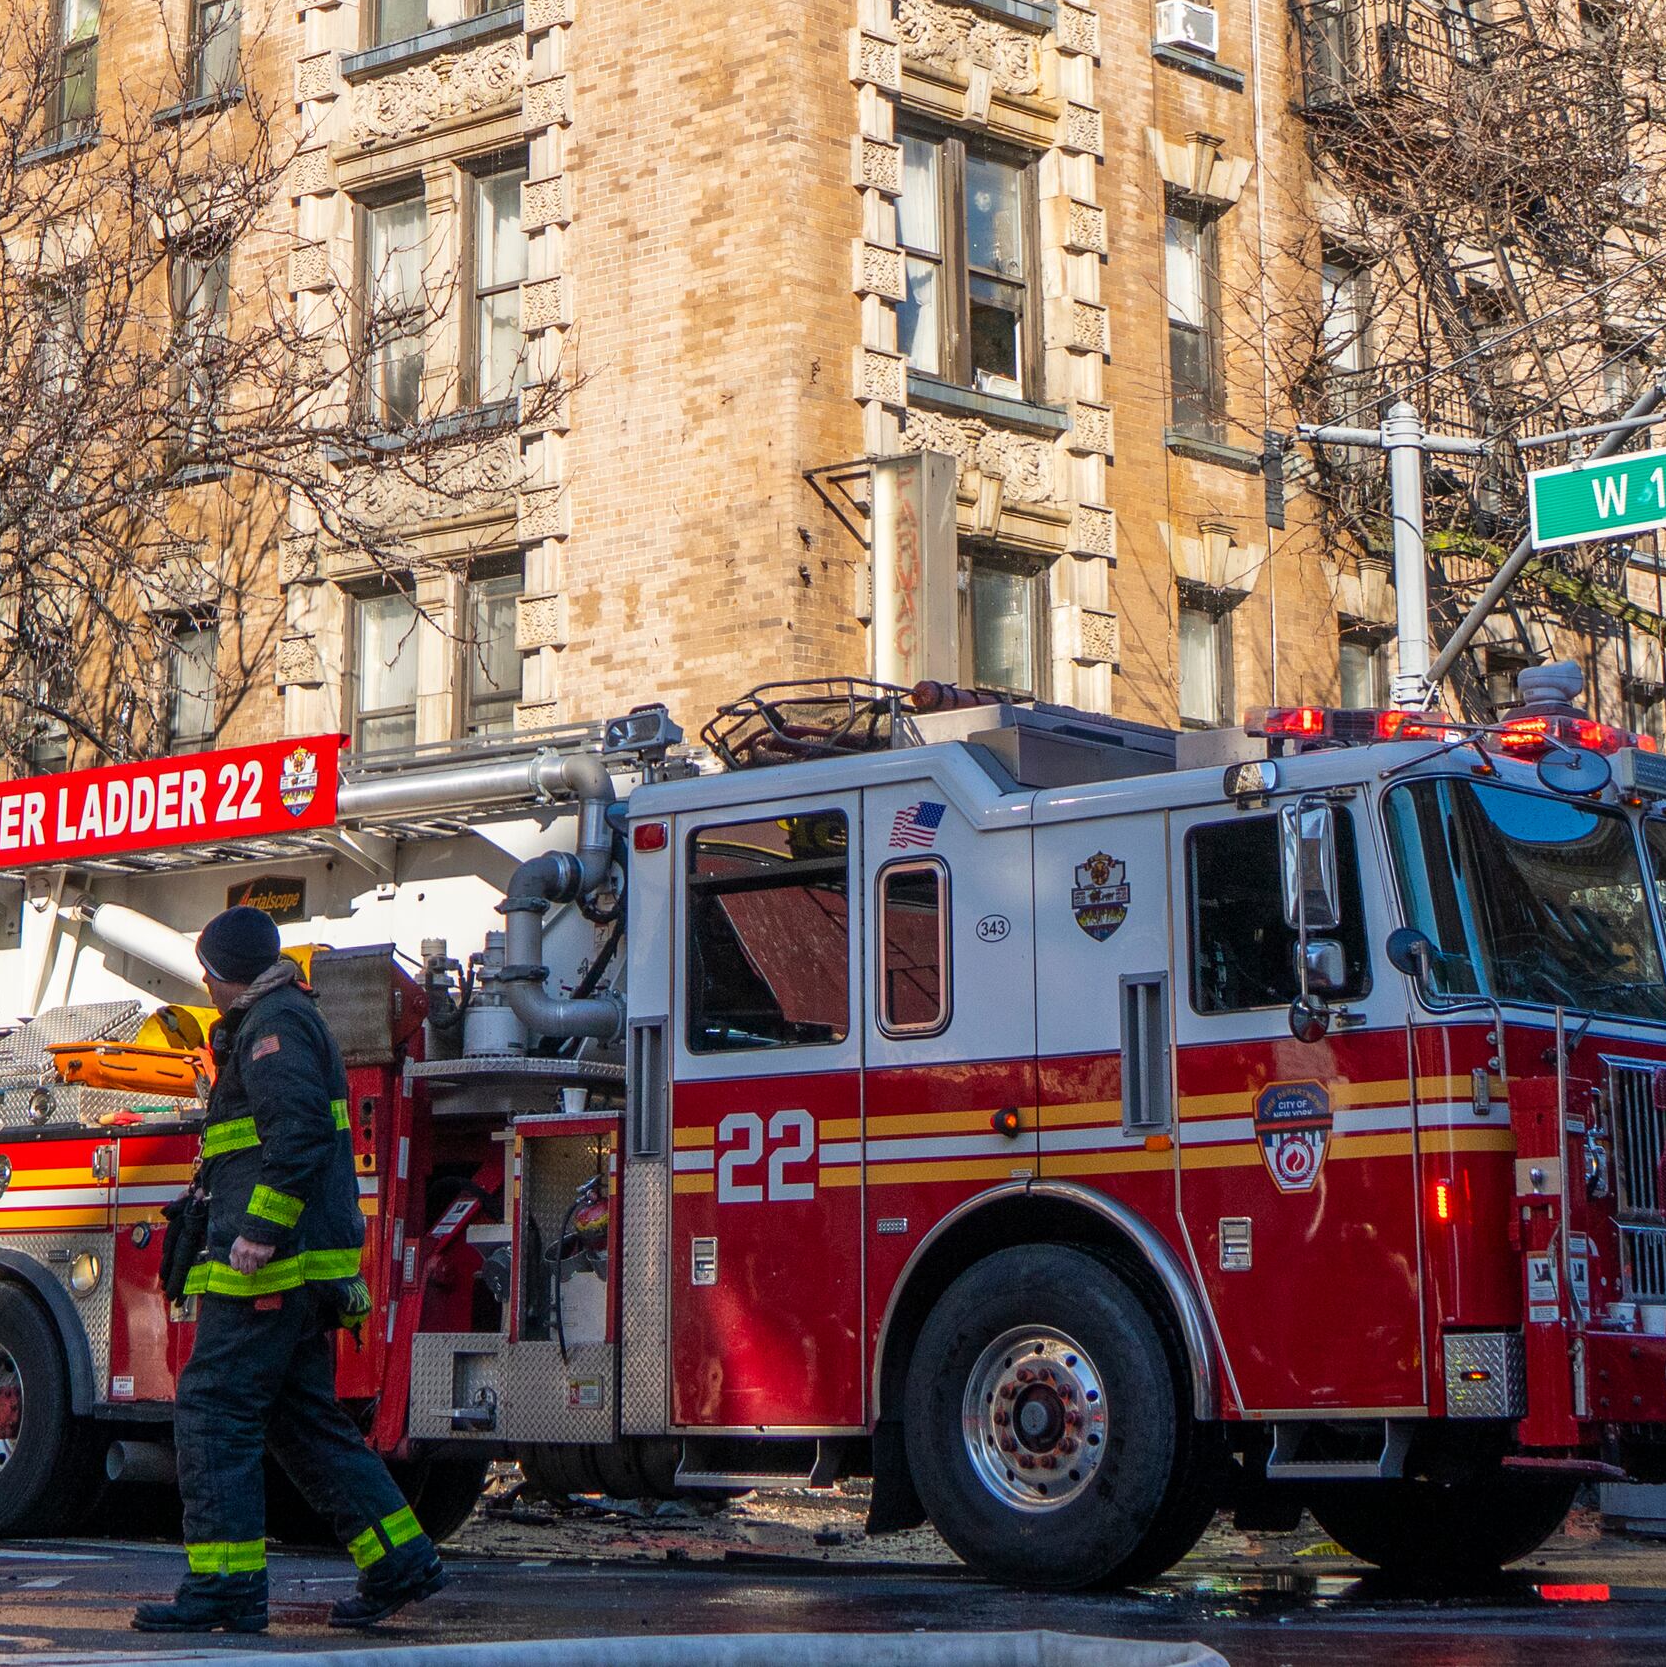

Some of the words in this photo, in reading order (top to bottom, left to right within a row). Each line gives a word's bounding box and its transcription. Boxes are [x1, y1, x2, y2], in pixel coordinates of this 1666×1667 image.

[1591, 473, 1628, 518] W
[56, 768, 207, 843] LADDER
[215, 759, 263, 823] 22
[239, 878, 300, 912] Aerialscope
[981, 920, 1005, 936] 343
[1278, 1101, 1296, 1110] CITY
[1297, 1100, 1308, 1109] OF
[718, 1110, 814, 1204] 22
